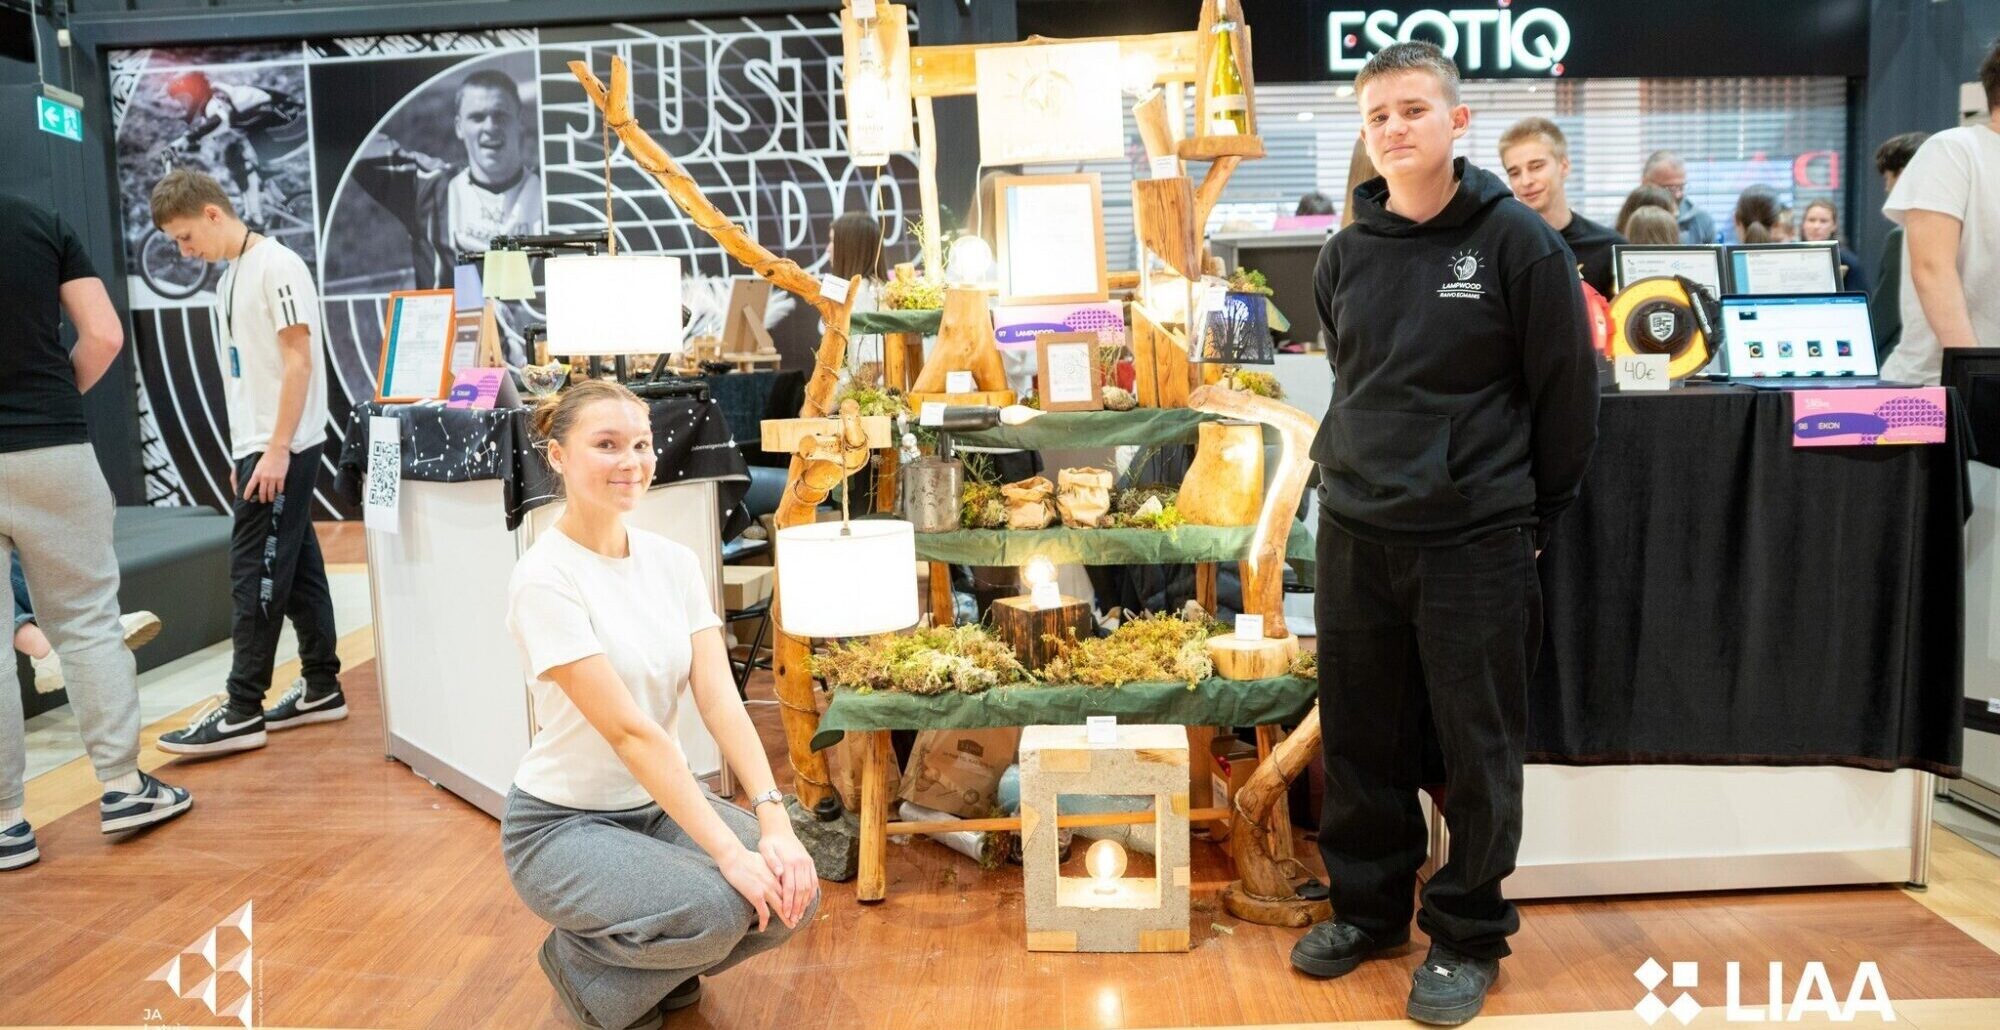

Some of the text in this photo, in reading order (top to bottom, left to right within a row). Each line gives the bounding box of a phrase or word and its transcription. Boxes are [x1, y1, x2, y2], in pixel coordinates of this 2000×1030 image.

[1328, 7, 1571, 72] ESOTIQ
[1624, 361, 1657, 380] 40€
[264, 535, 278, 558] NIKE
[260, 577, 274, 601] NIKE
